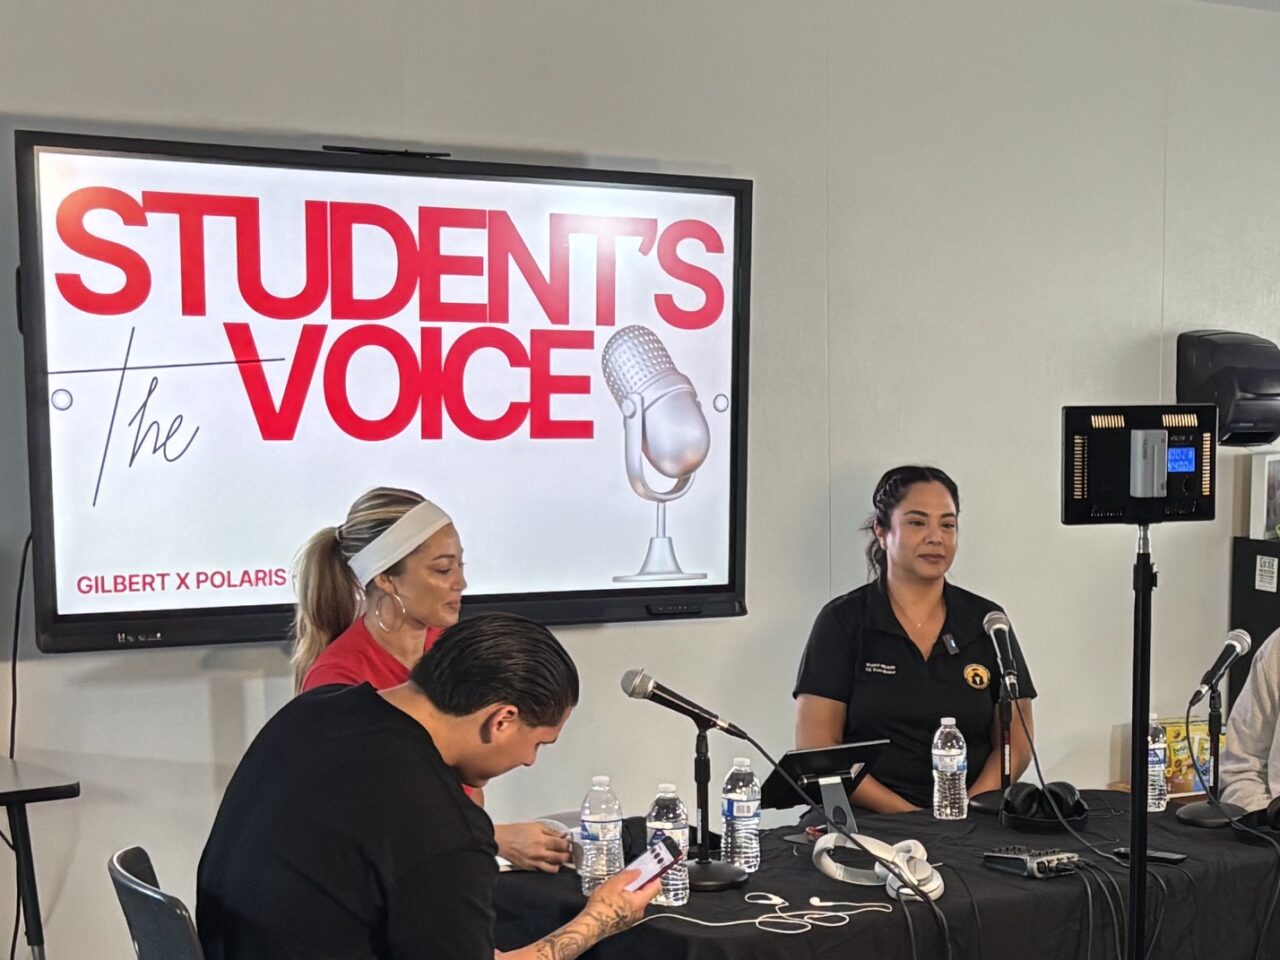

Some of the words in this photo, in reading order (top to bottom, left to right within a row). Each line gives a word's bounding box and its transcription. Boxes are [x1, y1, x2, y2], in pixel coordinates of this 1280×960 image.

[55, 186, 726, 330] STUDENT'S
[222, 322, 595, 441] VOICE
[76, 573, 170, 595] GILBERT
[176, 572, 190, 590] X
[196, 568, 287, 589] POLARIS
